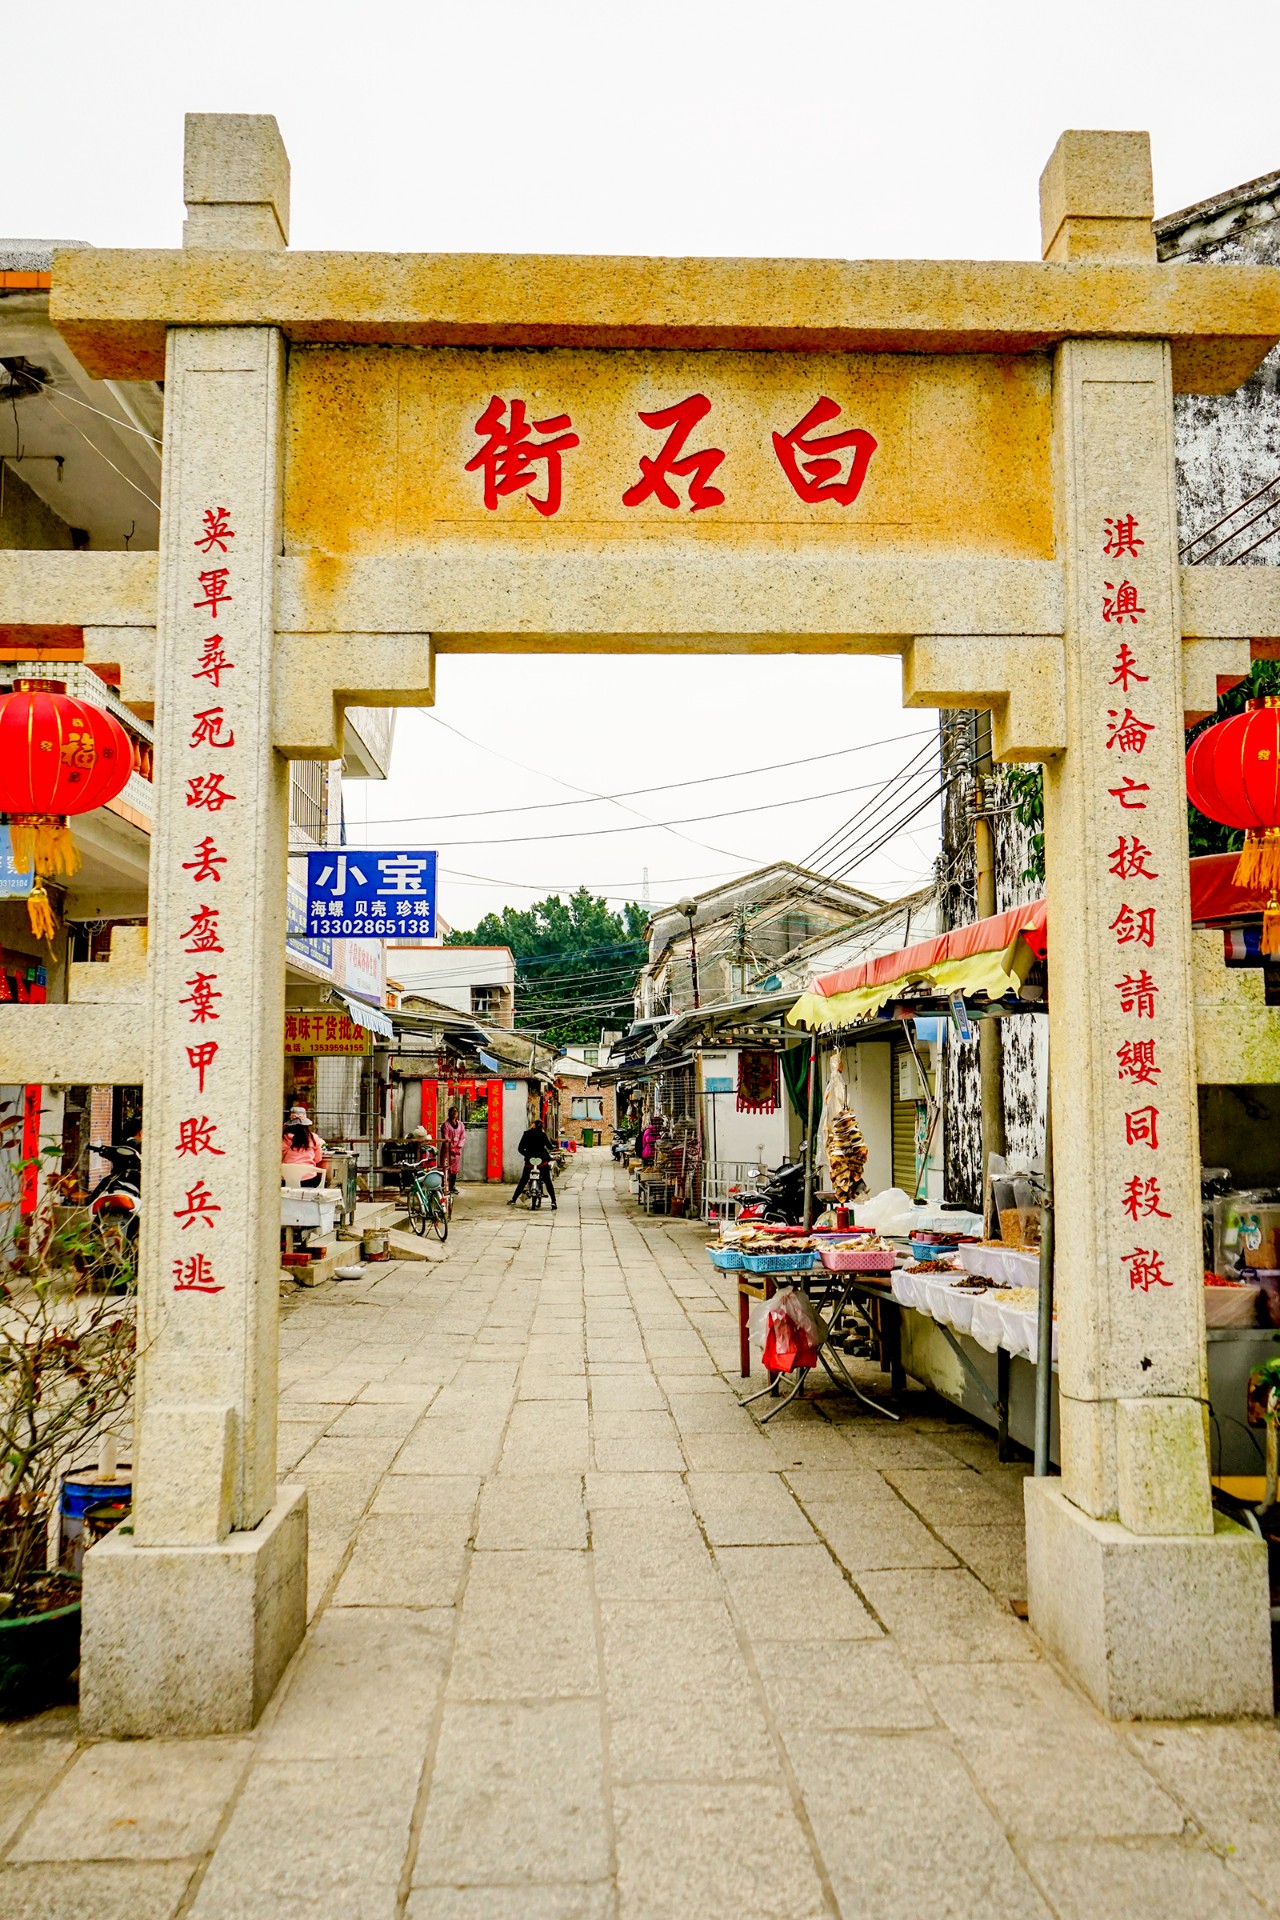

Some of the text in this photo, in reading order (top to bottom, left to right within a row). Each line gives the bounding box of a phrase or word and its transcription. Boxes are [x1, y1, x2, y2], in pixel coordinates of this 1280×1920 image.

[314, 854, 427, 896] 小宝
[310, 900, 430, 917] 海螺 贝壳 珍珠
[310, 919, 430, 934] 13302865138
[285, 1015, 365, 1041] 海味干货批发
[310, 1043, 364, 1052] 13539594155
